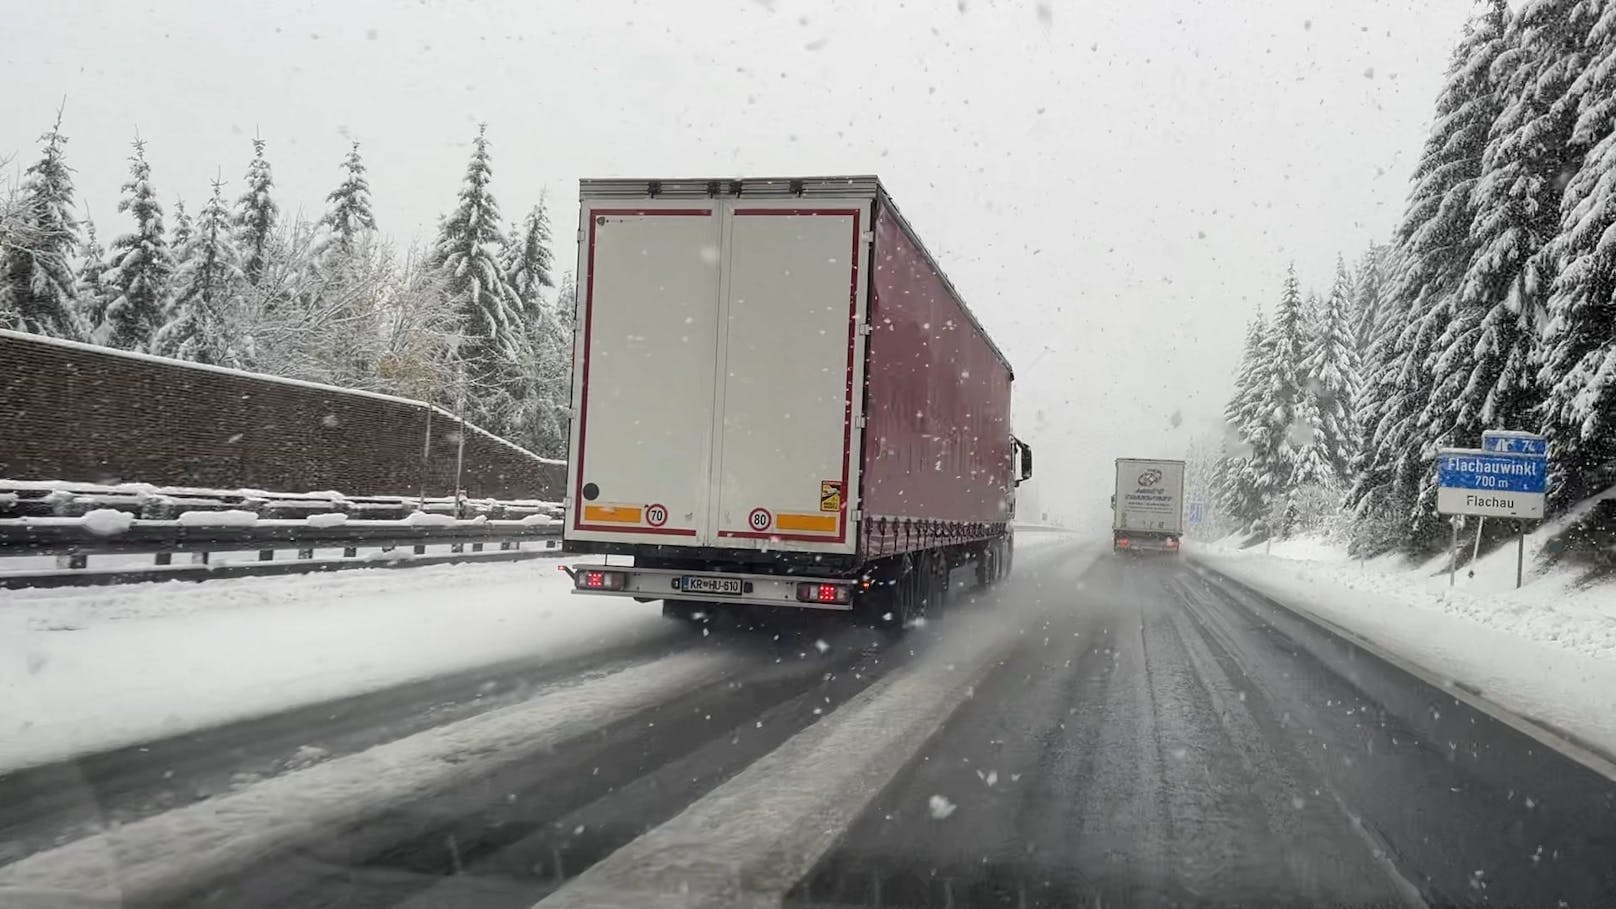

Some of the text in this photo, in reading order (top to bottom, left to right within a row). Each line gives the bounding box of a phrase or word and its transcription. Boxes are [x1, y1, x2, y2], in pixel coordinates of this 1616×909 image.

[1448, 458, 1537, 476] Flachauwinkl
[1475, 476, 1509, 488] 700 m
[1466, 495, 1514, 509] Flachau
[651, 510, 663, 521] 70
[754, 514, 767, 526] 80
